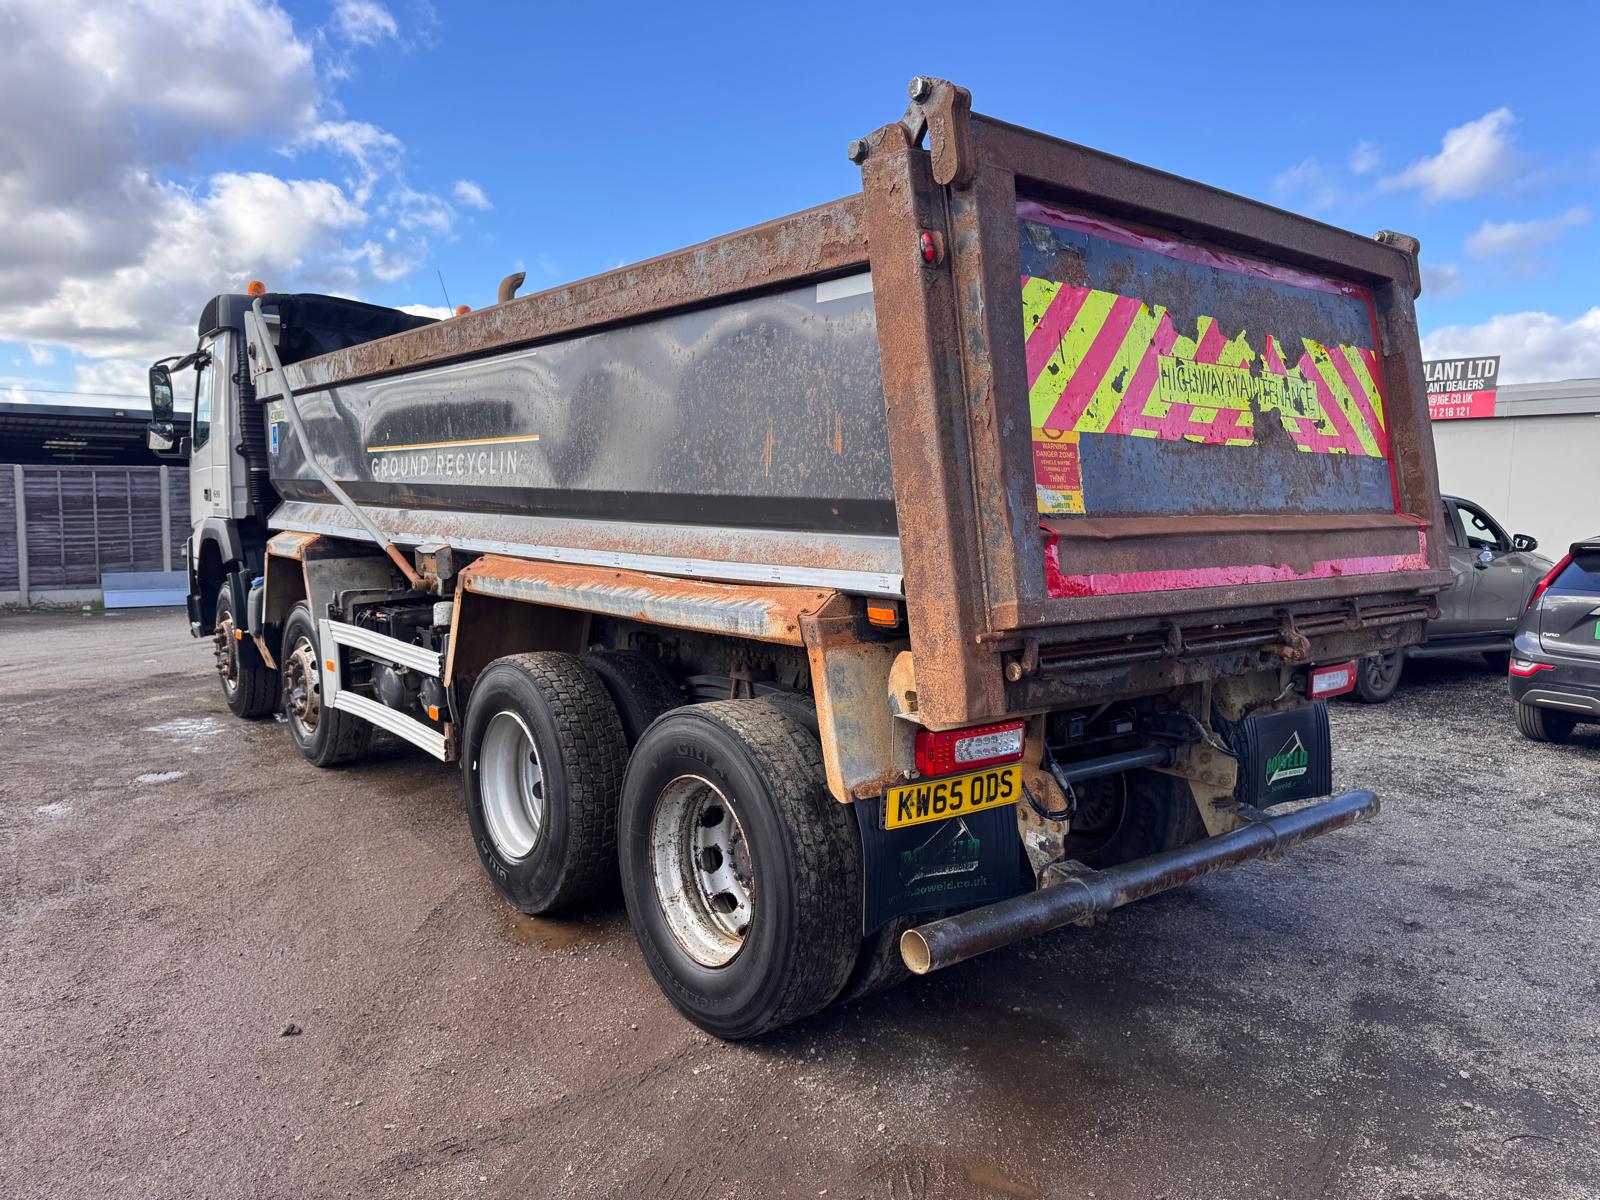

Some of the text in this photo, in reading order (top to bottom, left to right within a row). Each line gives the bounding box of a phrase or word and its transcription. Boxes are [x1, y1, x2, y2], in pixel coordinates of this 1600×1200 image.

[1467, 359, 1496, 379] LTD
[1161, 364, 1225, 396] HIGHWAY
[1426, 379, 1485, 394] ANT DEALERS
[1439, 407, 1454, 417] 218
[1457, 406, 1471, 417] 121
[1035, 450, 1058, 458] DANGER
[1042, 443, 1068, 451] WARNING
[371, 450, 519, 477] GROUND RECYCLIN
[897, 769, 1014, 822] KW65 ODS
